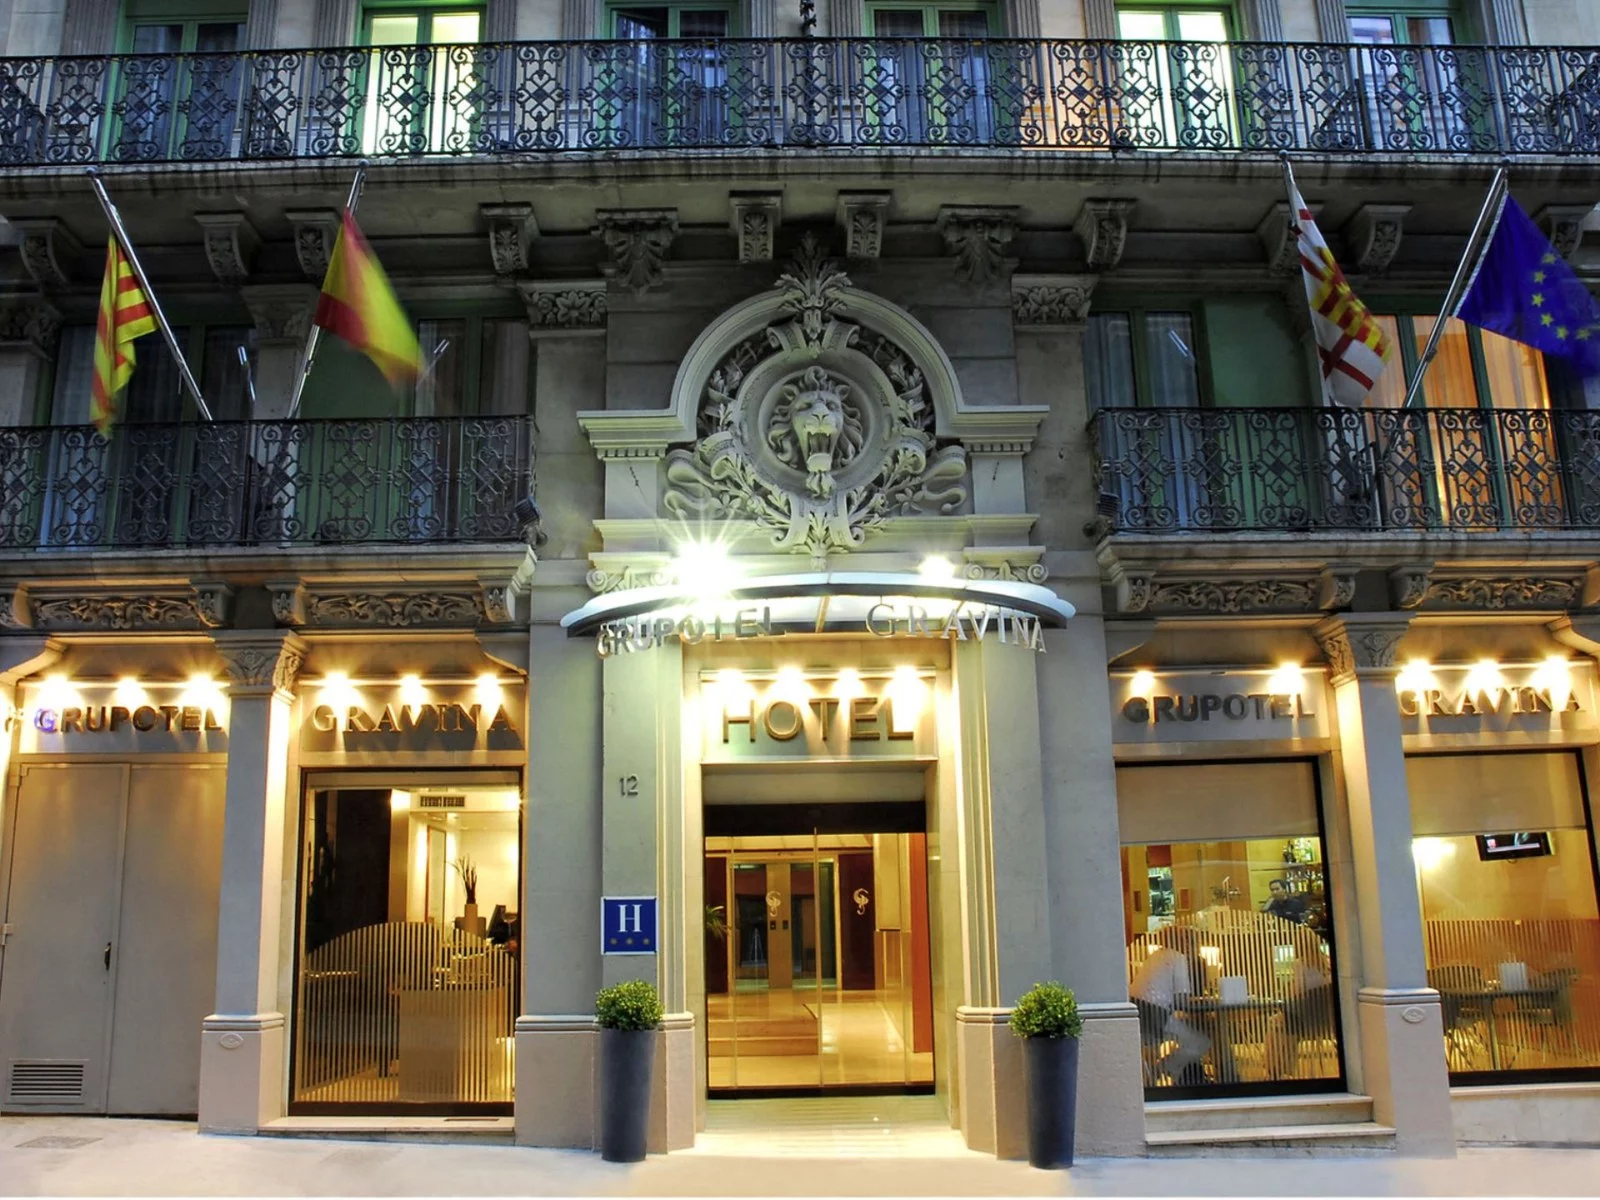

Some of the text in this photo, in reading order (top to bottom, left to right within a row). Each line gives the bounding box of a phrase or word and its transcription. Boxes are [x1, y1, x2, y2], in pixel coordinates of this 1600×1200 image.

[596, 603, 1047, 660] GRUPOTEL GRAVINA
[1122, 693, 1315, 725] GRUPOTEL
[1400, 686, 1587, 716] GRAVINA
[34, 705, 223, 733] GRUPOTEL
[312, 702, 517, 732] GRAVINA
[723, 696, 914, 743] HOTEL
[619, 775, 639, 796] 12
[618, 904, 642, 932] H
